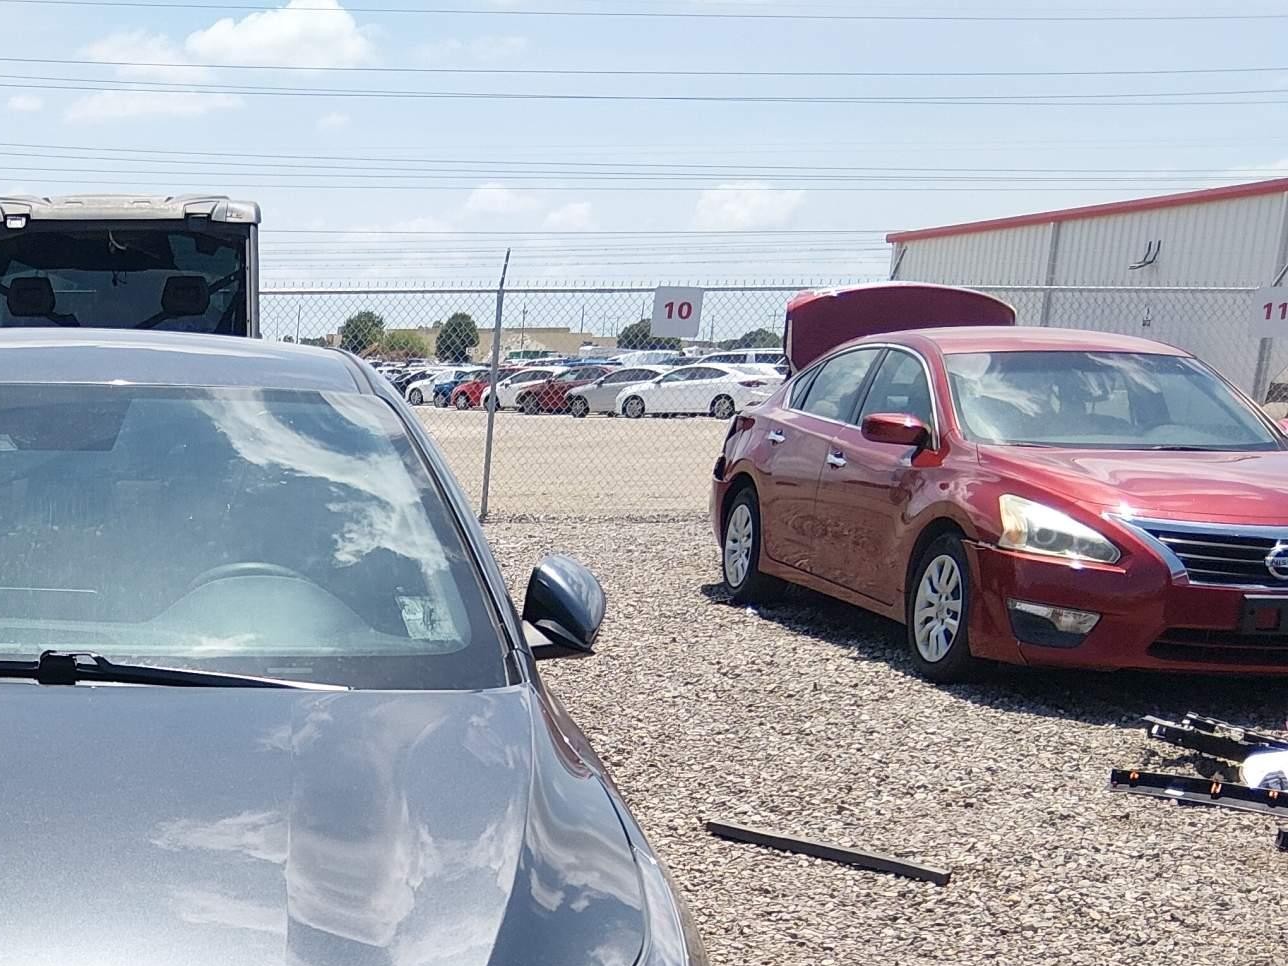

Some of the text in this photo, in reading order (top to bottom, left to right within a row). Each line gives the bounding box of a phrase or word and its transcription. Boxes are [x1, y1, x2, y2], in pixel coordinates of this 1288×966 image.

[664, 301, 692, 320] 10
[1263, 302, 1288, 320] 11
[1271, 558, 1288, 567] NIS
